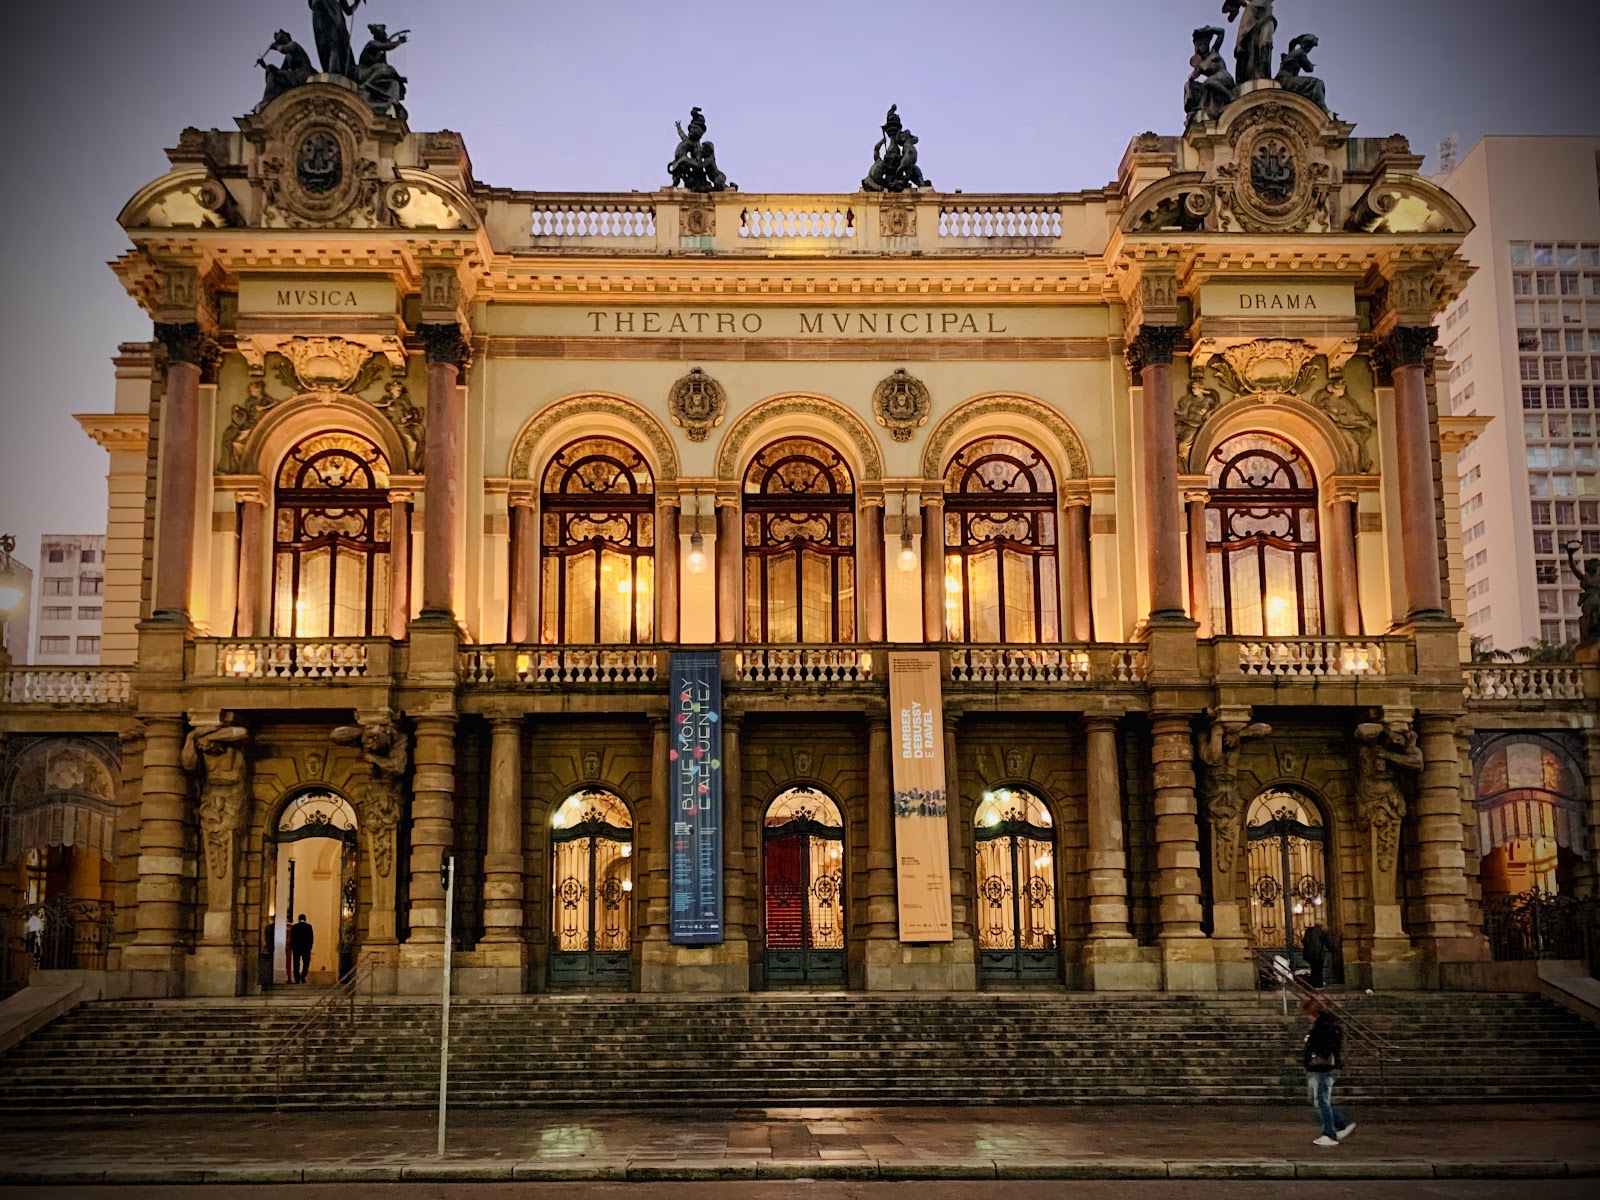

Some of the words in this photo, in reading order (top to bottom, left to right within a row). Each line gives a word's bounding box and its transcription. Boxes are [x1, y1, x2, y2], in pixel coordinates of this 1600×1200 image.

[277, 290, 358, 306] MVSICA
[1239, 294, 1317, 309] DRAMA
[587, 312, 763, 333] THEATRO
[799, 313, 1008, 334] MVNICIPAL
[682, 677, 694, 751] MONDAY
[901, 709, 912, 759] BARBER
[912, 701, 923, 759] DEBUSSY
[923, 709, 934, 748] RAVEL
[682, 759, 694, 810] BLUE
